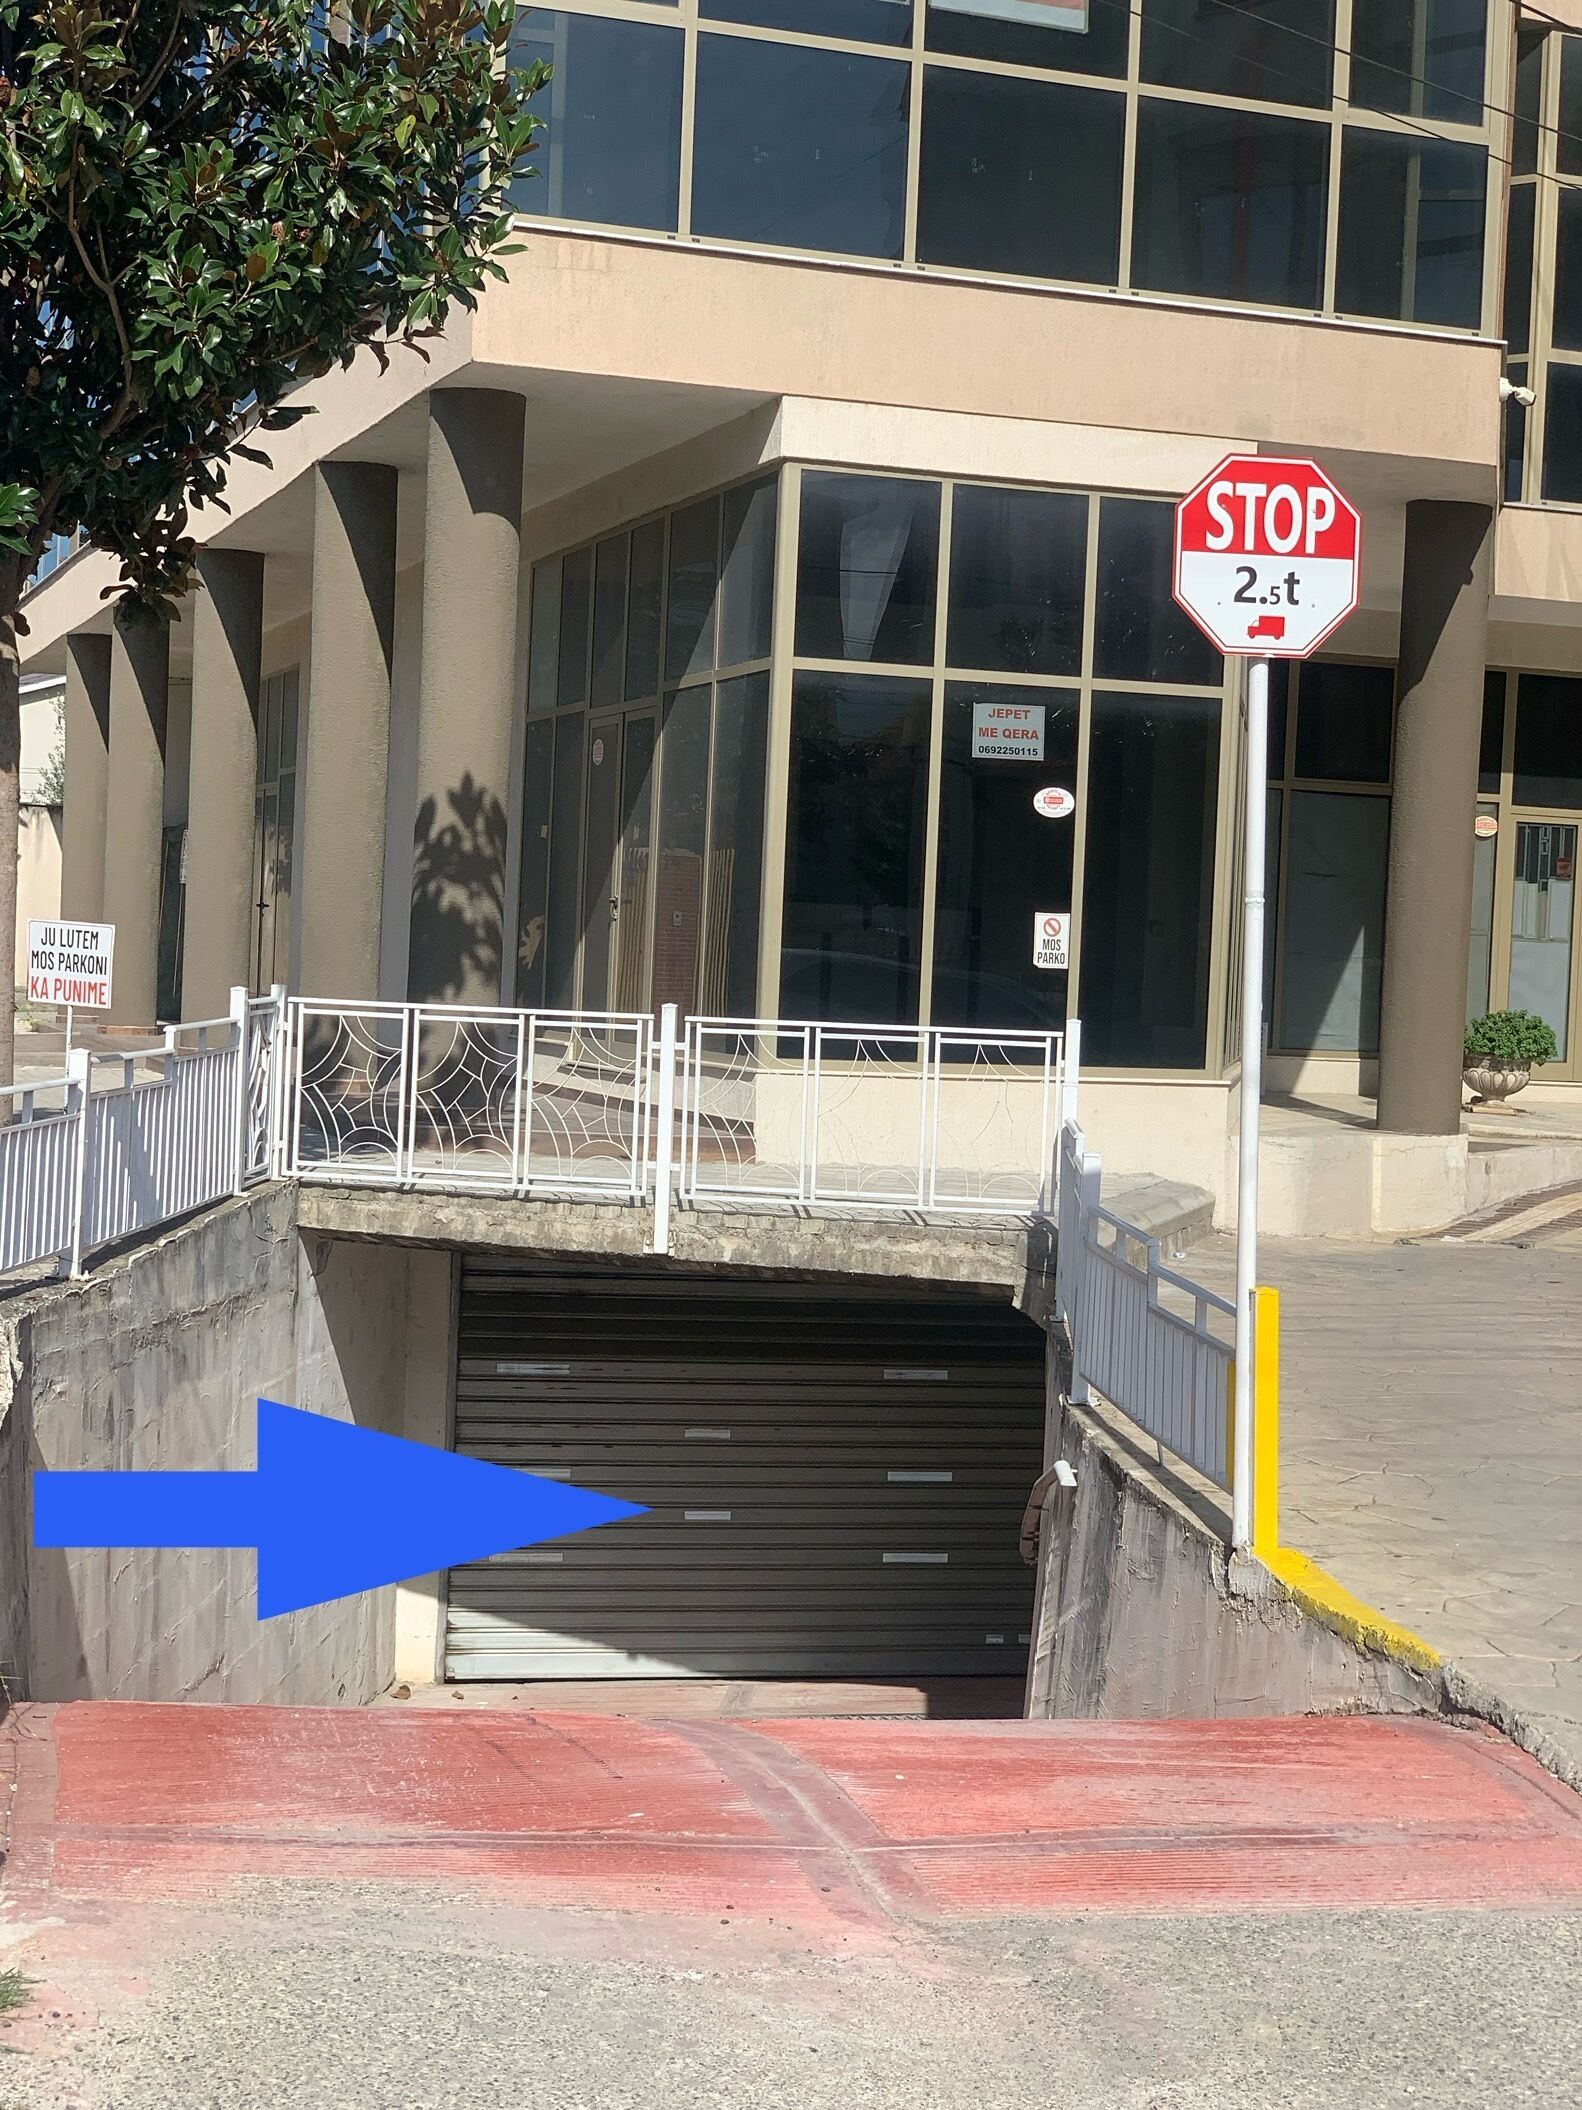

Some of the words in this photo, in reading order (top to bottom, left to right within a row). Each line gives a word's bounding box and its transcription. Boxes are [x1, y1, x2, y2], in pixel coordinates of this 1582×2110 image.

[1205, 480, 1336, 555] STOP
[1233, 565, 1301, 606] 2.5t
[988, 708, 1031, 720] JEPET
[978, 727, 998, 738] ME
[1002, 728, 1039, 740] QERA
[978, 745, 1038, 756] 0692250115
[40, 927, 56, 947] JU
[60, 928, 99, 950] LUTEM
[1042, 938, 1062, 951] MOS
[31, 950, 55, 971] MOS
[58, 952, 107, 976] PARKONI
[1037, 952, 1066, 965] PARKO
[30, 975, 49, 1000] KA
[53, 977, 107, 1005] PUNIME
